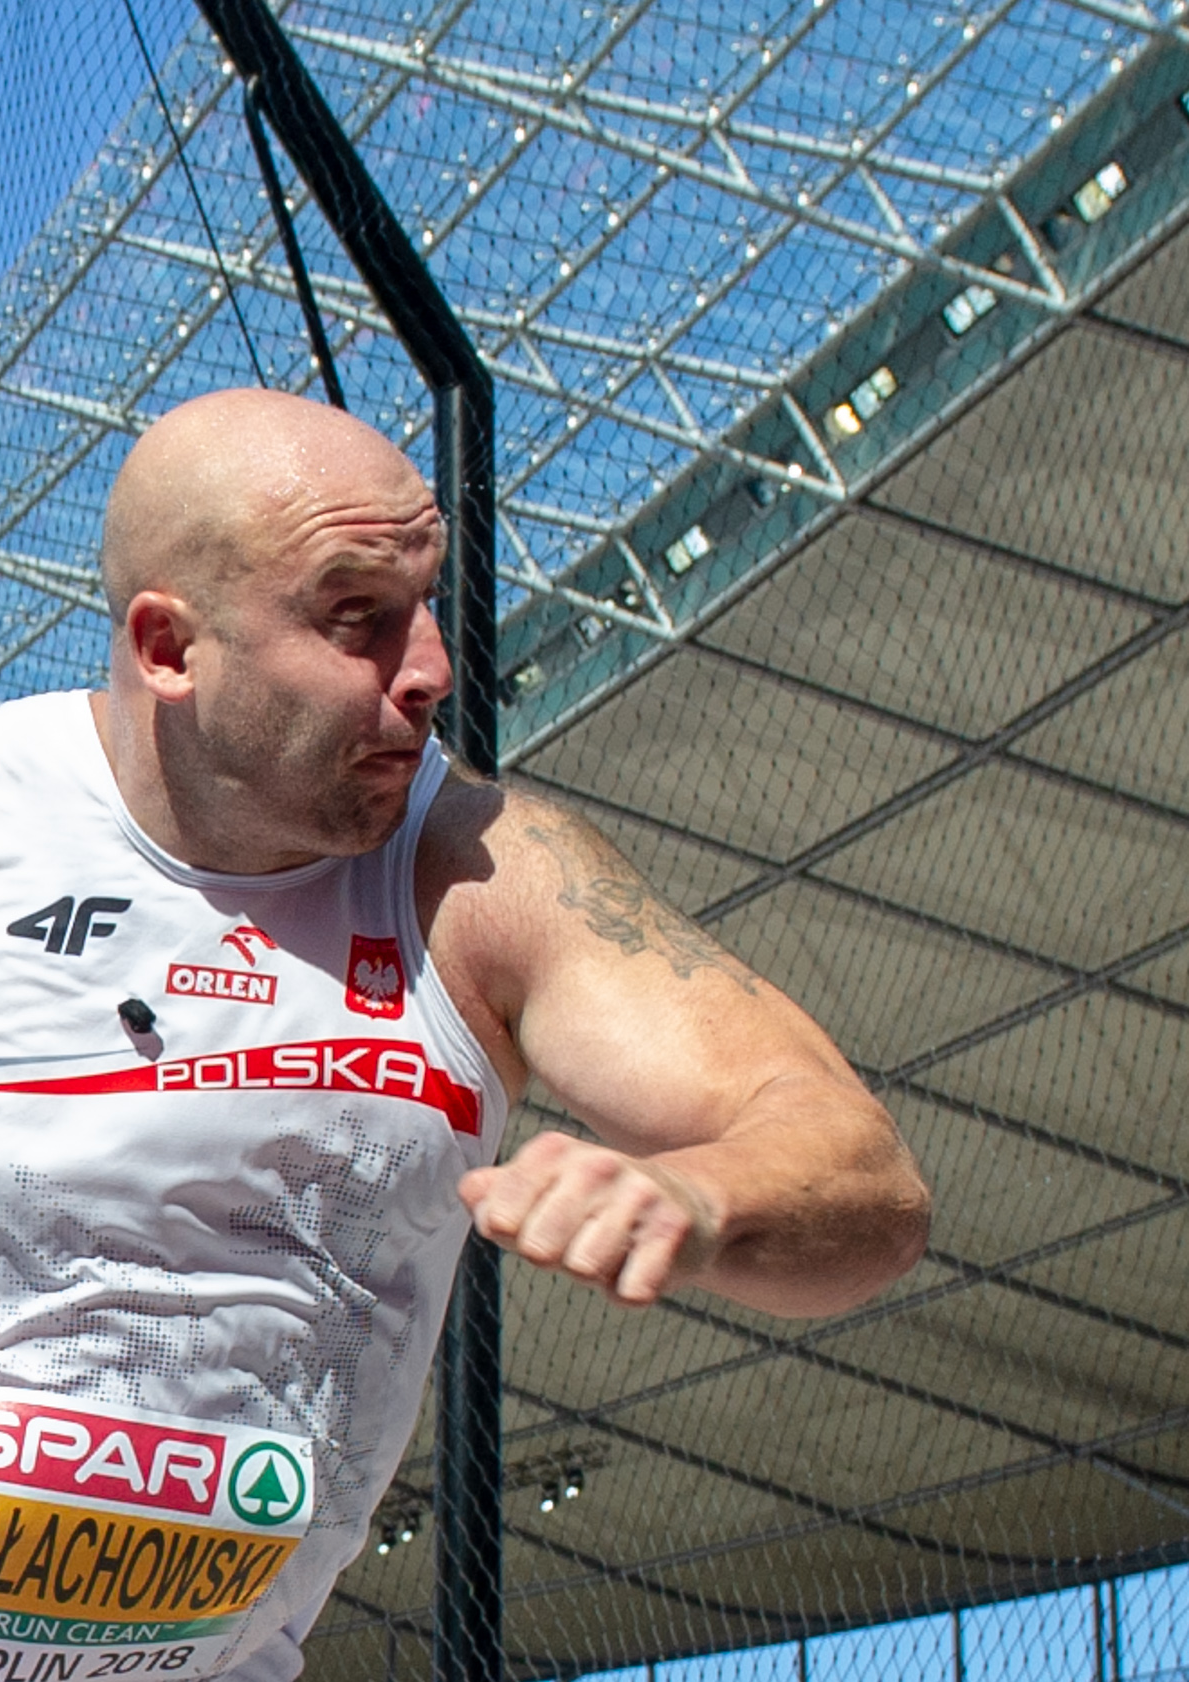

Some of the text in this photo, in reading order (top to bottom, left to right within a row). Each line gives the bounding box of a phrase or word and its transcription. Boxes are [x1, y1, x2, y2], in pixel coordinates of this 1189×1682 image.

[6, 895, 132, 956] 4F
[172, 968, 271, 1001] ORLEN
[155, 1046, 426, 1098] POLSKA
[87, 1645, 194, 1679] 2018
